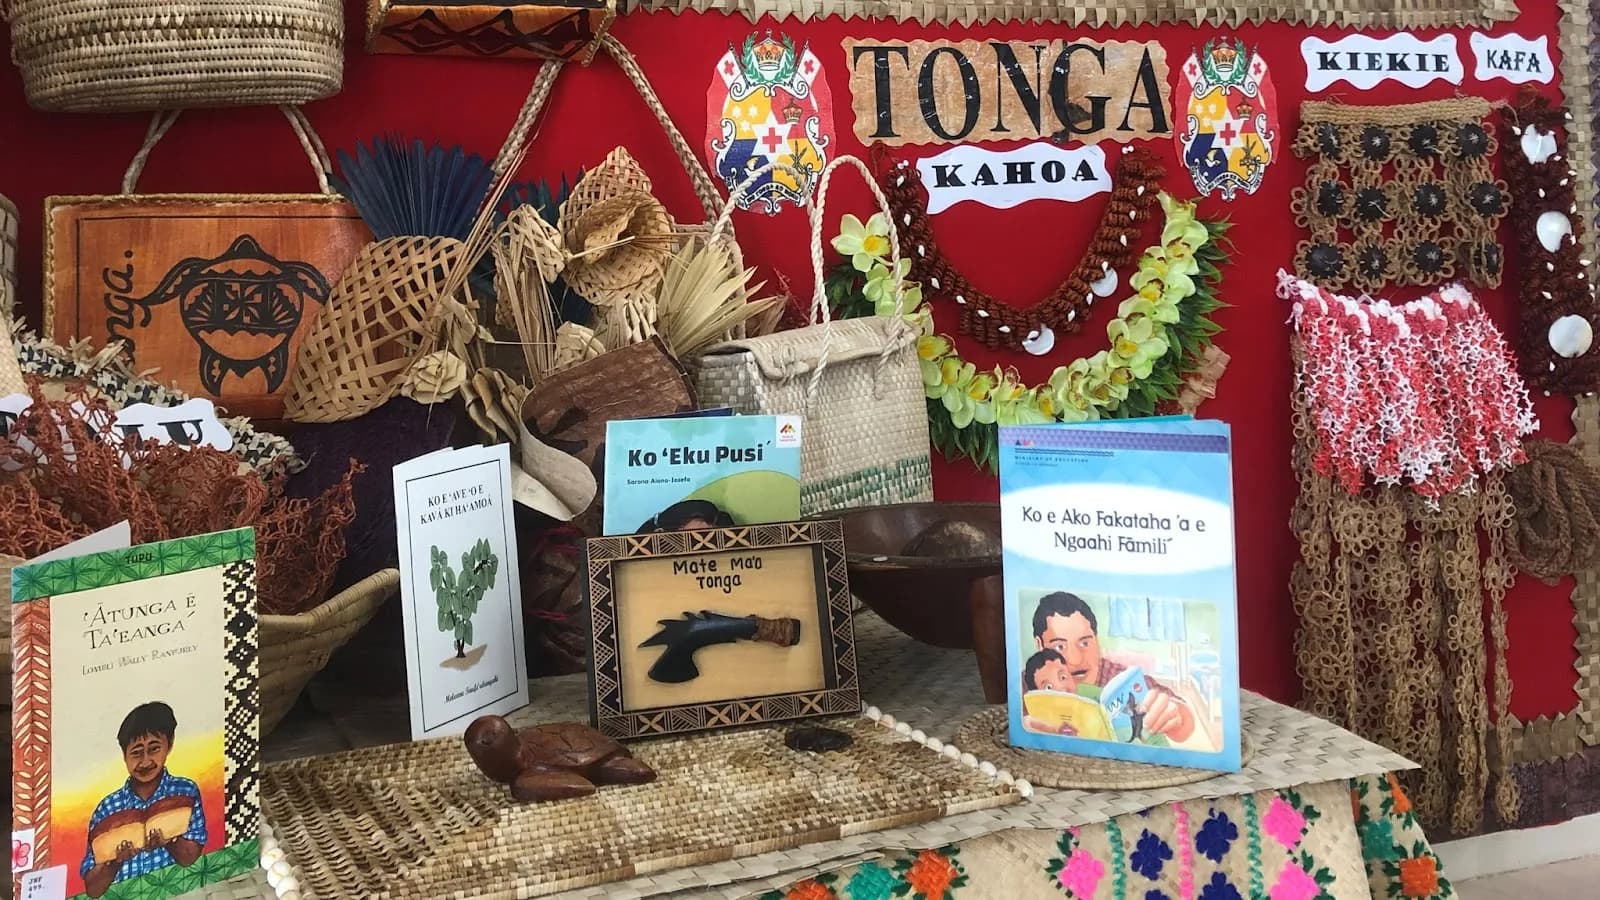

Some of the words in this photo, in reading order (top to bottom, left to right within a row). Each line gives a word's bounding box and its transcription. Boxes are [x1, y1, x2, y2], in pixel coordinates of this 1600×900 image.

[1316, 51, 1450, 72] KIEKIE
[1487, 49, 1542, 73] KAFA
[852, 42, 1170, 141] TONGA
[931, 159, 1098, 188] KAHOA
[628, 449, 657, 467] Ko
[428, 495, 440, 507] KO
[442, 493, 448, 504] E
[478, 484, 484, 494] E
[444, 506, 453, 518] KI
[1022, 506, 1042, 523] Ko
[1047, 510, 1056, 523] e
[1061, 508, 1091, 526] Ako
[1096, 510, 1171, 530] Fakataha
[1196, 519, 1206, 532] e
[1054, 531, 1112, 552] Ngaahi
[673, 558, 717, 575] Mate
[696, 574, 742, 594] Tonga
